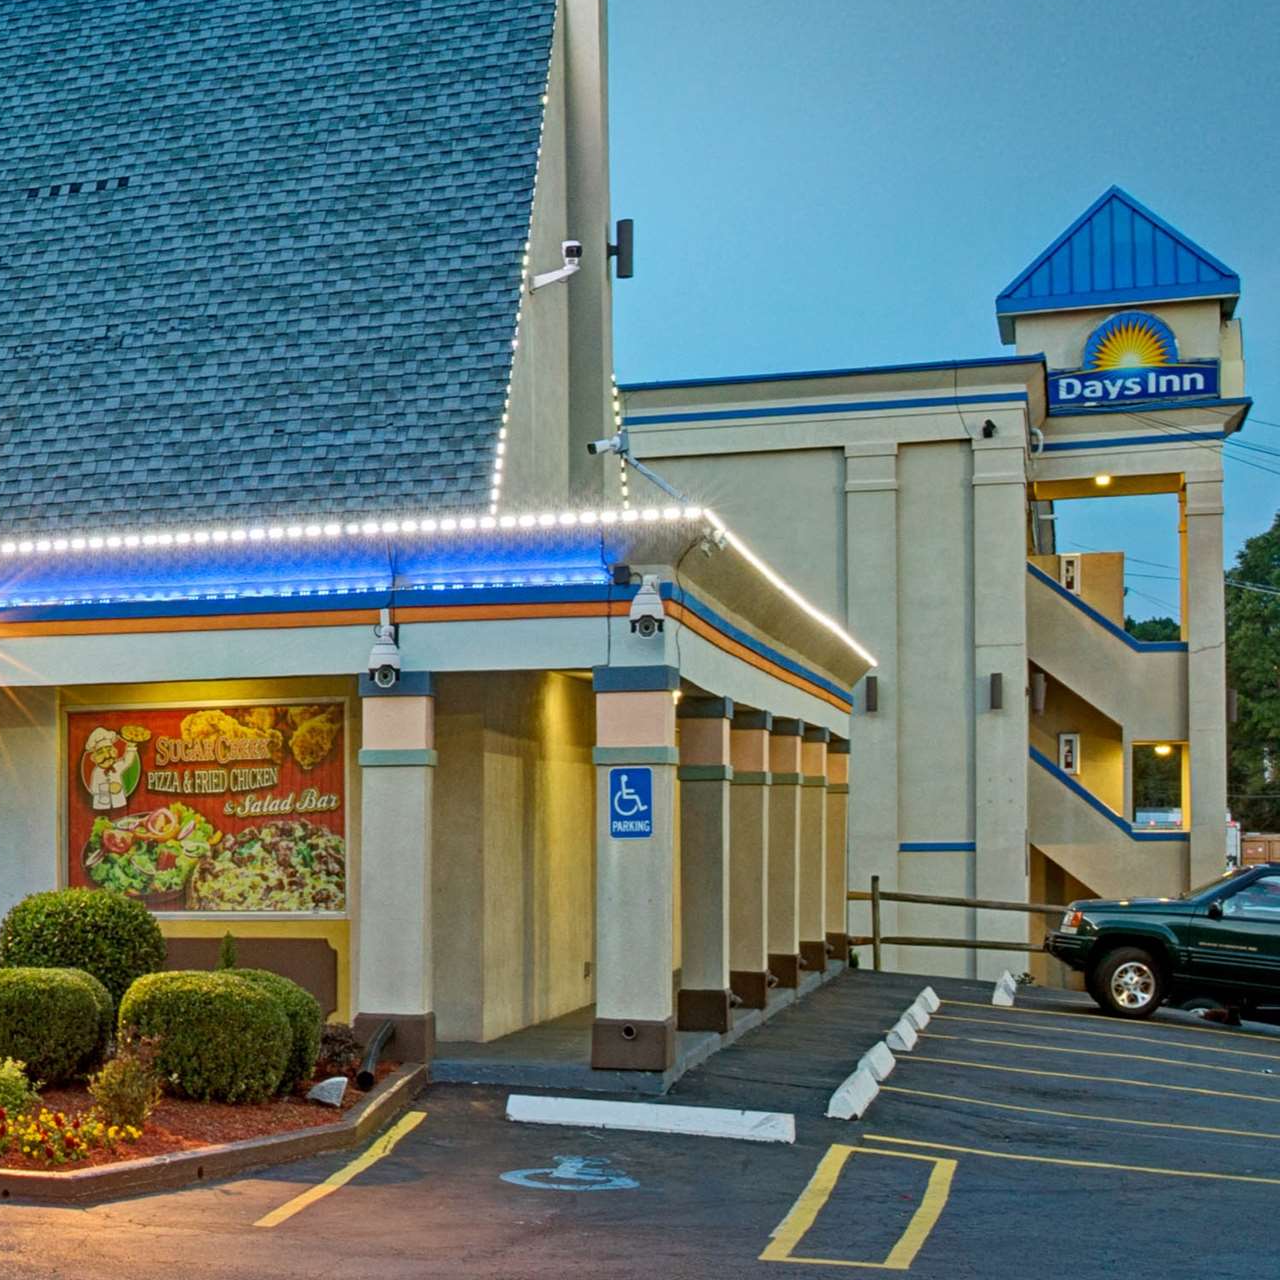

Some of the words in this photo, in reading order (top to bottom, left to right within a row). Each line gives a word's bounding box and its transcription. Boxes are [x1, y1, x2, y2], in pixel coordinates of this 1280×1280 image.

[1058, 378, 1142, 400] Days
[1147, 372, 1205, 393] Inn
[155, 736, 215, 766] SUGAR
[147, 771, 181, 793] PIZZA
[183, 770, 193, 793] &
[194, 770, 227, 793] FRIED
[229, 767, 278, 792] CHICKEN
[238, 794, 294, 817] Salad
[296, 788, 337, 811] Bar
[612, 820, 651, 832] PARKING
